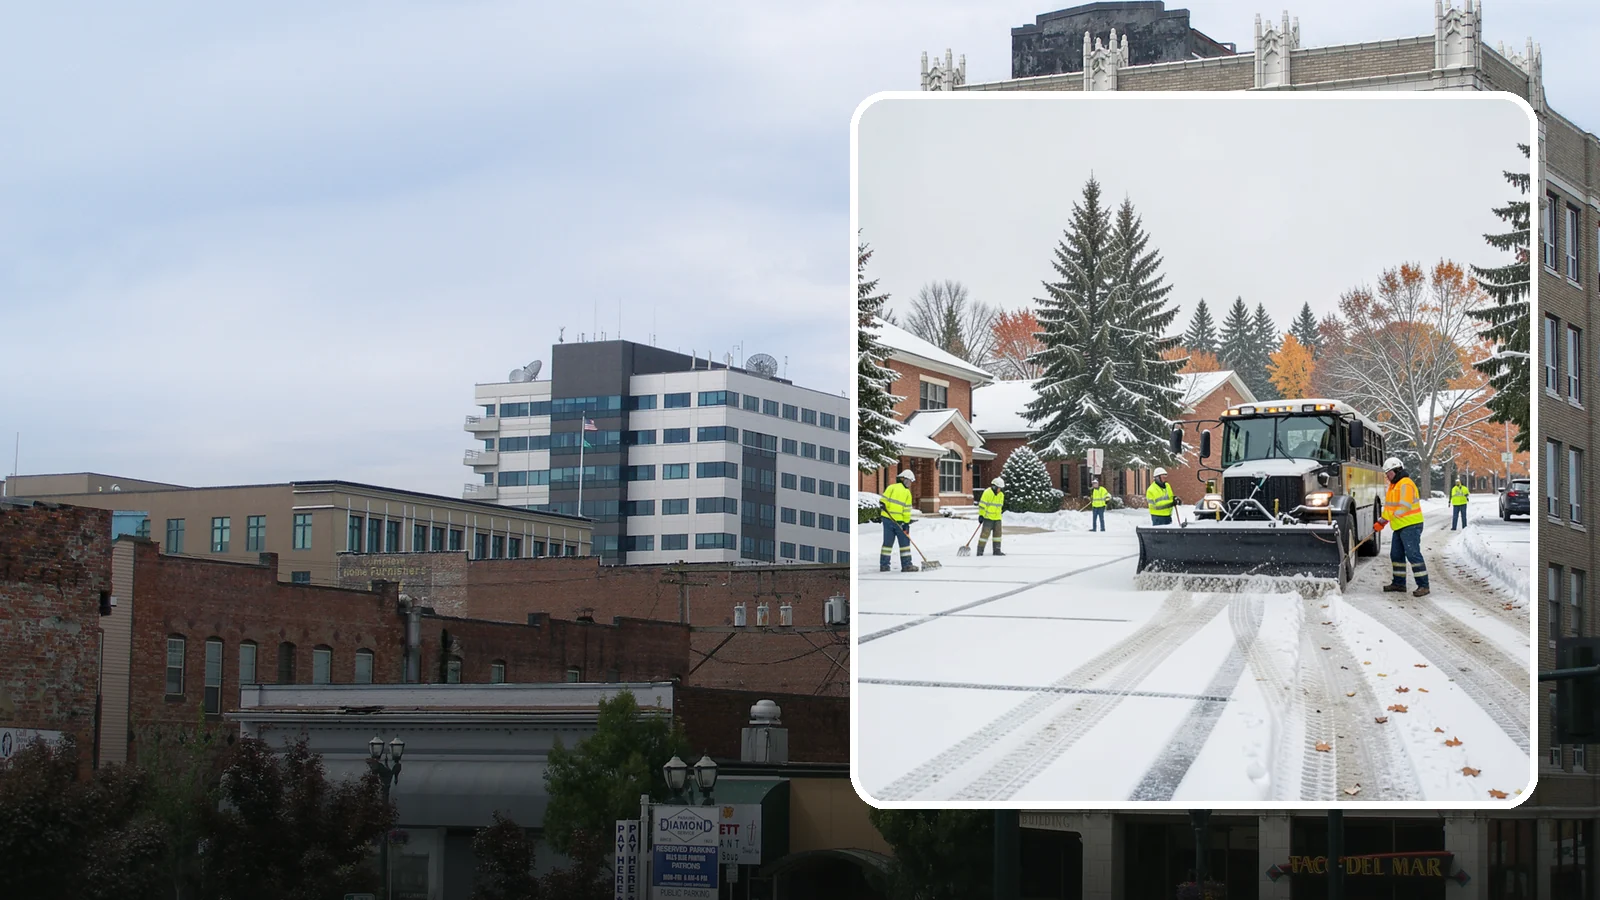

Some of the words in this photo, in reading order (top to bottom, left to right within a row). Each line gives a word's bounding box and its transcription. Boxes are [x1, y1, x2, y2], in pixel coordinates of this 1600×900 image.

[343, 568, 367, 577] Home
[370, 566, 427, 576] Furnishers
[660, 818, 713, 833] DIAMOND
[1022, 815, 1069, 828] BUILDING
[617, 825, 625, 852] PAY
[628, 825, 636, 852] PAY
[656, 845, 688, 853] RESERVED
[689, 846, 716, 854] PARKING
[671, 862, 701, 870] PATRONS
[1289, 855, 1330, 874] TAC
[1346, 856, 1384, 875] DEL
[1391, 857, 1442, 877] MAR
[616, 856, 625, 893] HERE
[627, 856, 636, 893] HERE
[660, 889, 682, 897] PUBLIC
[683, 889, 710, 898] PARKING
